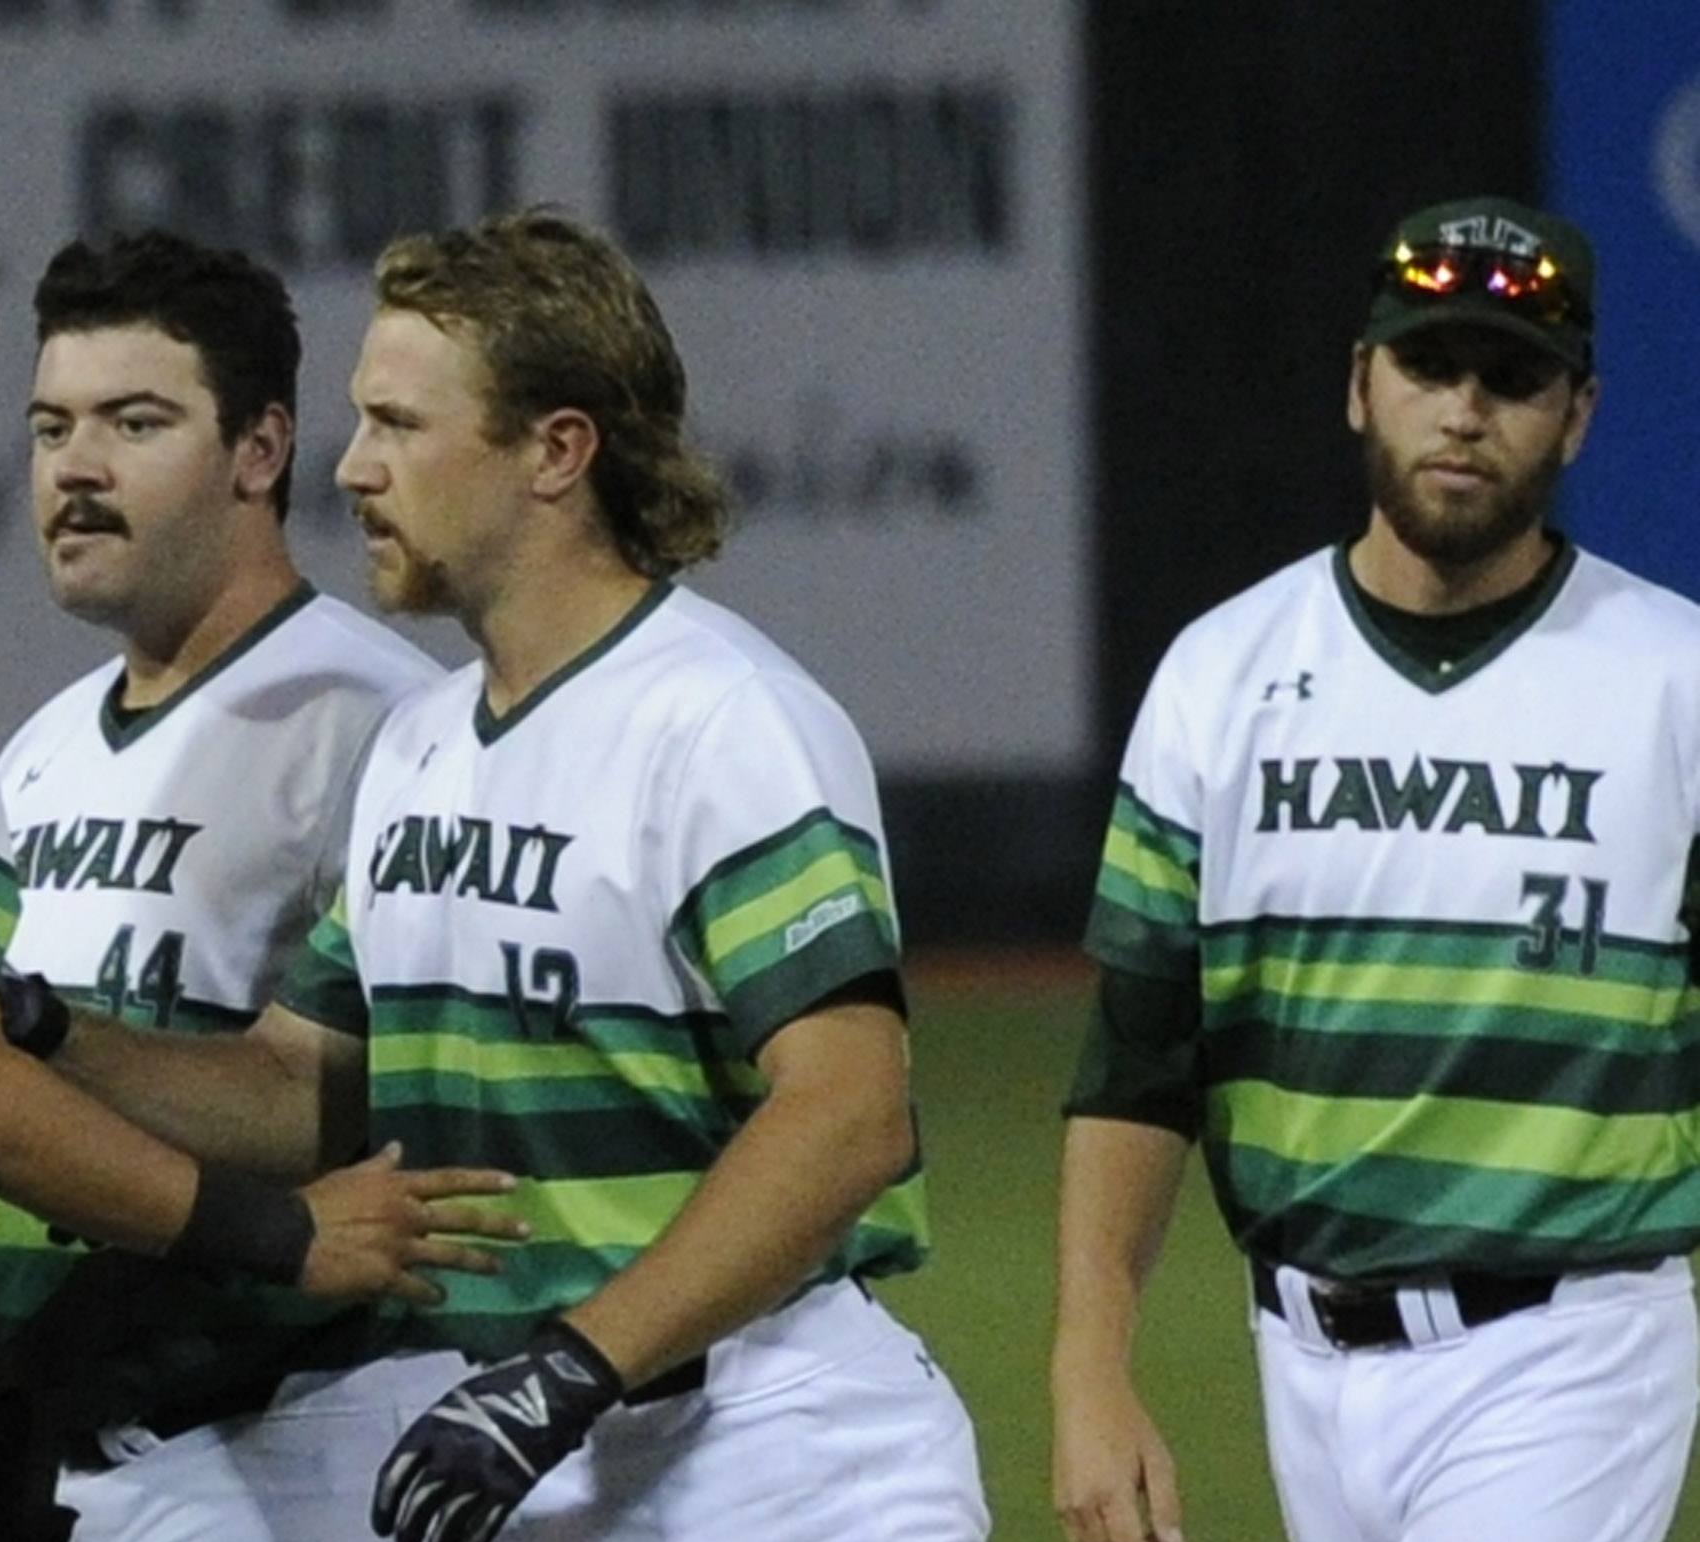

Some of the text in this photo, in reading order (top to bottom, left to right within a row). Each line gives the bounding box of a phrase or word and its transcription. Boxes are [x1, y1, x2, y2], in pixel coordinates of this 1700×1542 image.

[96, 923, 185, 1029] 44
[1513, 872, 1610, 976] 31
[498, 939, 590, 1040] 12
